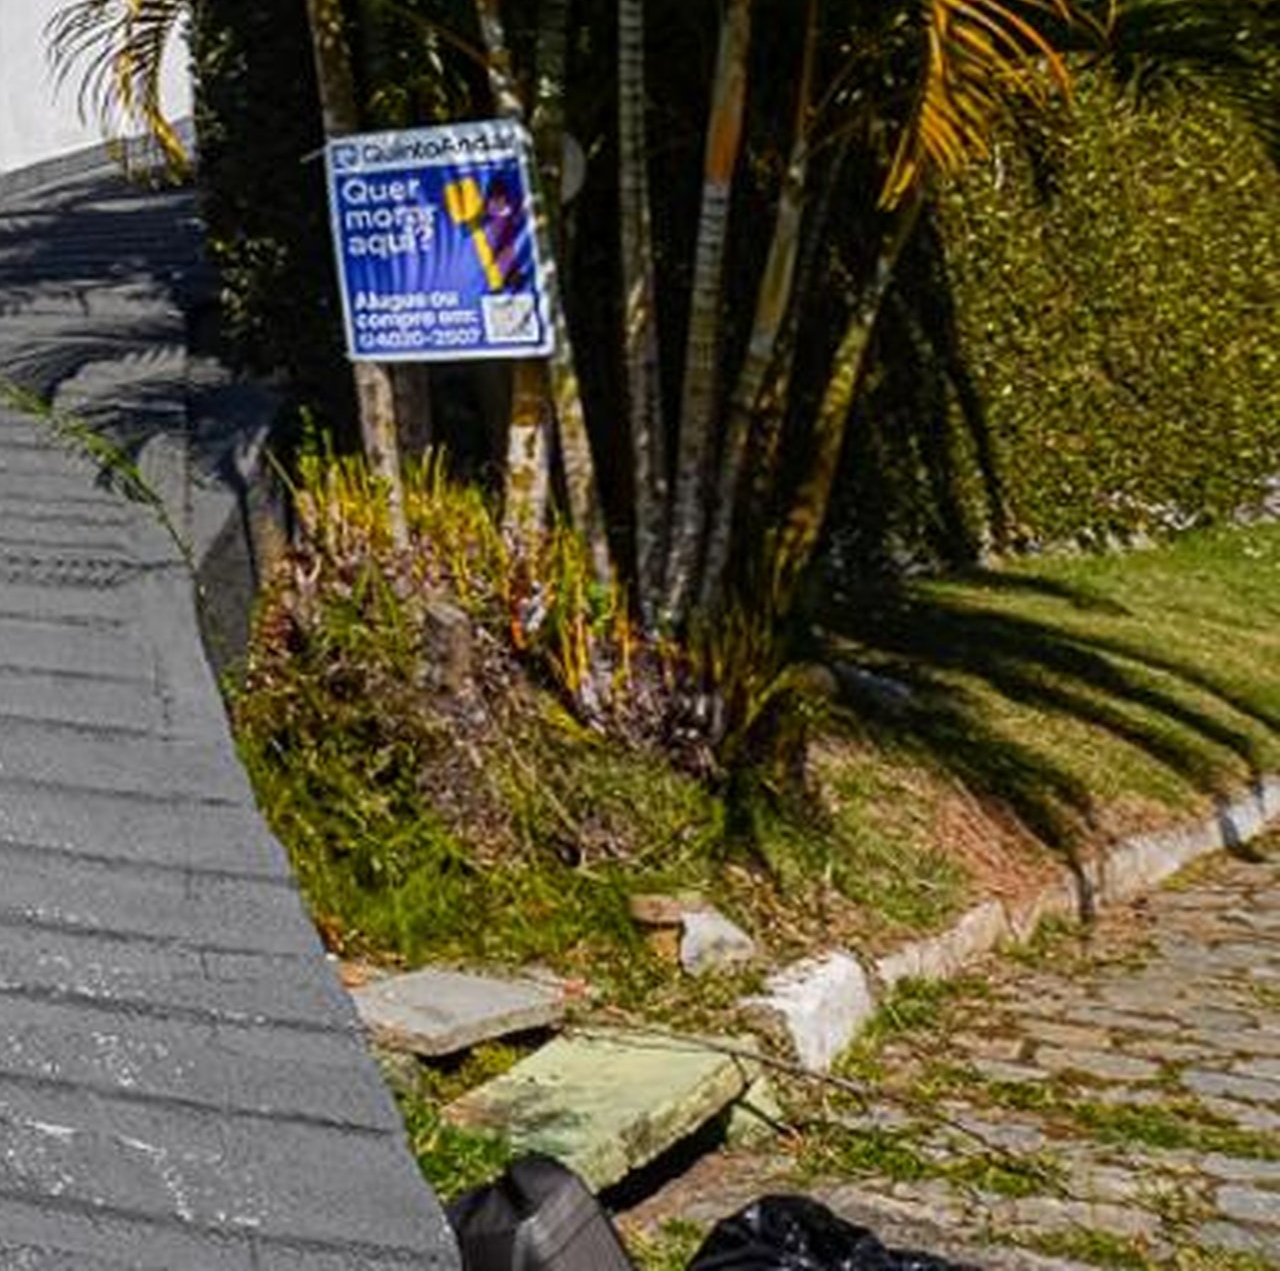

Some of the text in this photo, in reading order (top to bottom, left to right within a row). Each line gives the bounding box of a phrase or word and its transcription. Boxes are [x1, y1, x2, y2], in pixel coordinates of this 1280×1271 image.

[342, 179, 420, 203] Quer
[346, 207, 435, 229] morar
[348, 228, 433, 258] aqui?
[354, 291, 459, 311] Alugue ou
[356, 312, 436, 332] compre
